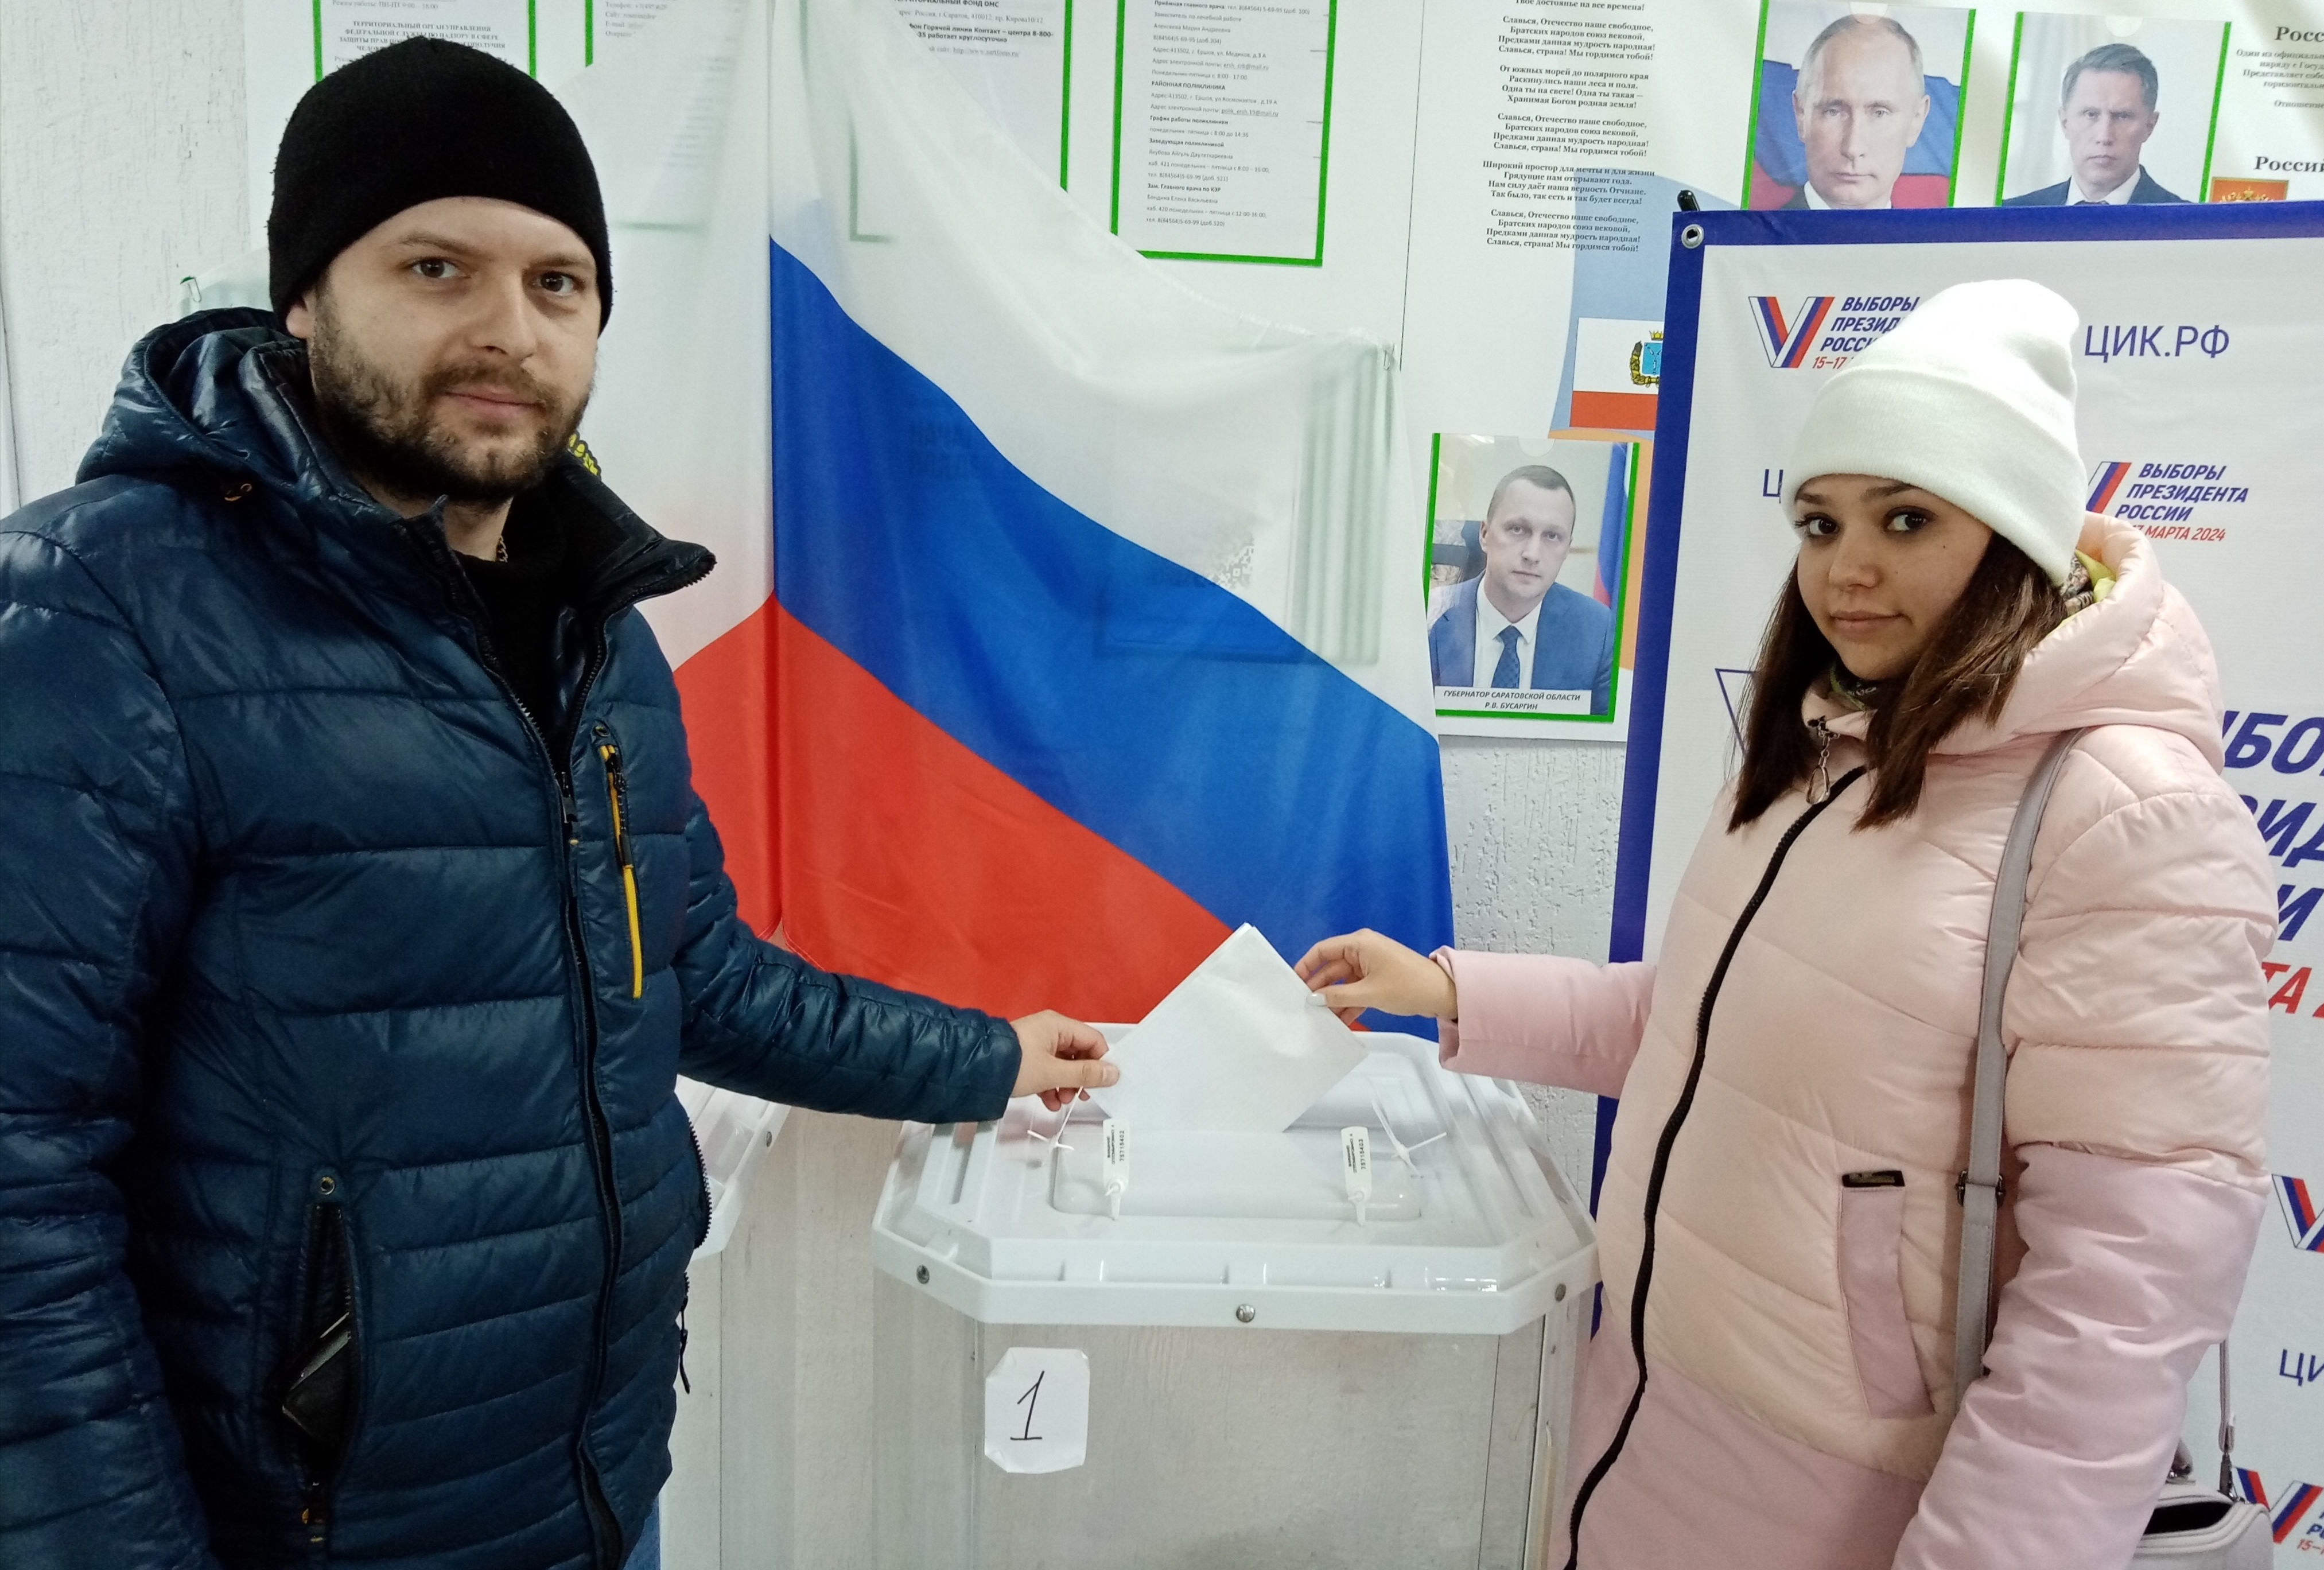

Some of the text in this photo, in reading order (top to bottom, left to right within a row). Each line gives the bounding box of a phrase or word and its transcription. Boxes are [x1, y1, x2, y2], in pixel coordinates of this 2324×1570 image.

[1503, 15, 1538, 25] Славься,
[1541, 18, 1583, 26] Отечество
[1608, 22, 1653, 32] свободное,
[923, 24, 950, 32] Горячей
[1008, 29, 1031, 37] центра
[1510, 26, 1548, 35] Братских
[959, 35, 1008, 43] круглосуточно
[1498, 35, 1540, 44] Предками
[1499, 45, 1534, 55] Славься,
[1545, 68, 1571, 76] морей
[1584, 71, 1628, 79] полярного
[1509, 75, 1562, 85] Раскинулись
[1507, 95, 1549, 103] Хранимая
[1498, 113, 1533, 122] Славься,
[1535, 115, 1577, 123] Отечество
[1602, 119, 1647, 129] свободное,
[1505, 123, 1542, 131] Братских
[1494, 132, 1534, 141] Предками
[1149, 138, 1183, 146] Заведующая
[1494, 142, 1529, 151] Славься,
[1483, 161, 1523, 170] Широкий
[1525, 165, 1558, 173] простор
[1504, 172, 1545, 181] Грядущие
[1610, 187, 1646, 195] Отчизне.
[1507, 191, 1531, 200] было,
[1590, 195, 1612, 204] будет
[1491, 209, 1526, 218] Славься,
[1528, 211, 1569, 219] Отечество
[1595, 215, 1638, 224] свободное,
[1498, 219, 1535, 228] Братских
[1486, 228, 1527, 236] Предками
[1487, 238, 1522, 247] Славься,
[1841, 297, 1920, 312] ВЫБОРЫ
[1831, 317, 1905, 334] ПРЕЗИД
[2085, 325, 2229, 363] ЦИК.РФ
[2139, 463, 2227, 481] ВЫБОРЫ
[2126, 484, 2249, 503] ПРЕЗИДЕНТА
[2115, 504, 2193, 522] РОССИИ
[2145, 525, 2191, 540] МАРТА
[2191, 527, 2226, 542] 2024
[1444, 690, 1490, 698] ГУБЕРНАТОР
[1491, 691, 1545, 700] САРАТОВСКОЙ
[1500, 702, 1538, 710] БУСАРГИН
[1010, 1370, 1045, 1441] 1
